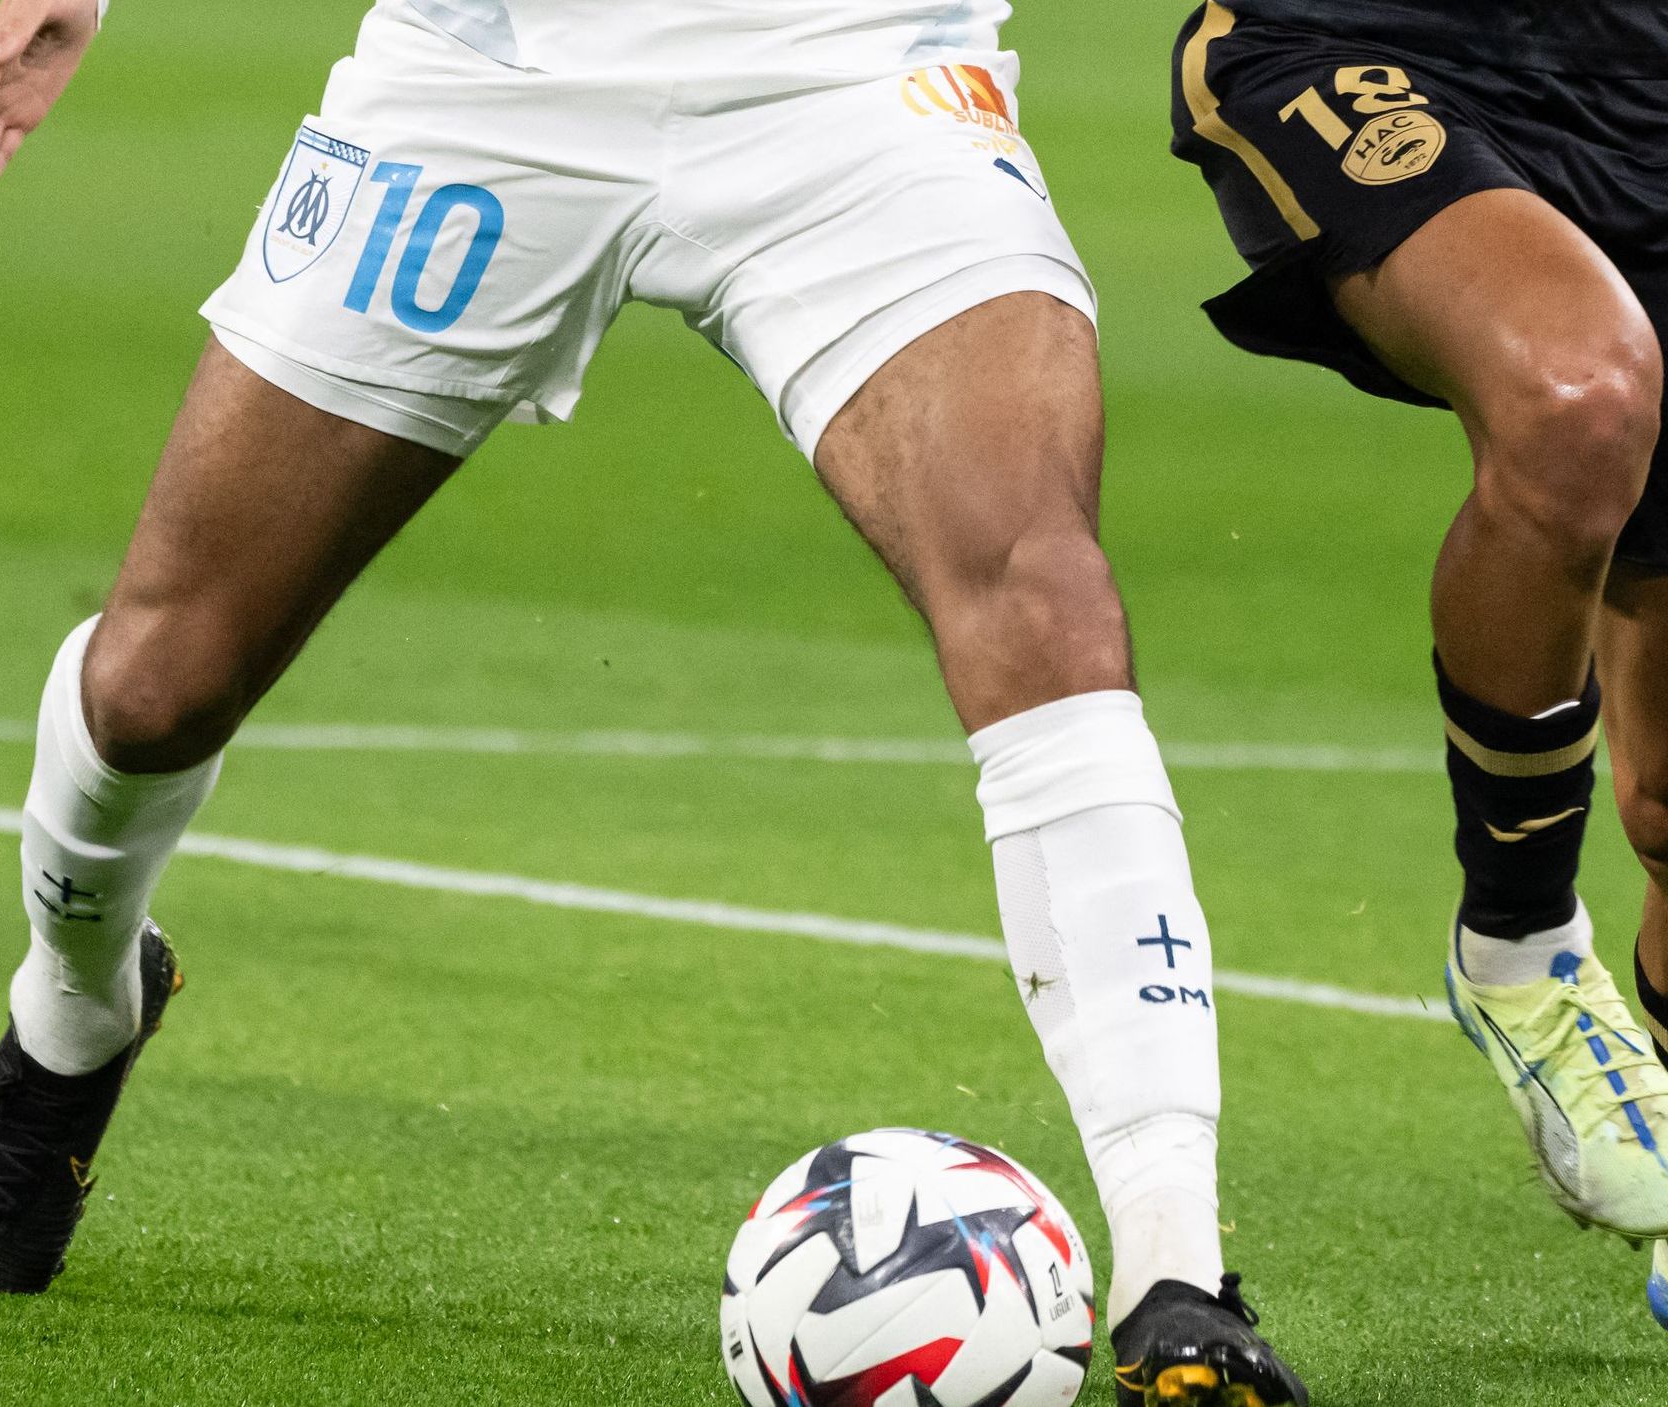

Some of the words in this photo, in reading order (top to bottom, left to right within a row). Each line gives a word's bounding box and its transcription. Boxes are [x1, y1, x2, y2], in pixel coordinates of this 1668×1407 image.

[1278, 65, 1430, 152] 18
[1355, 115, 1414, 160] HAC
[343, 161, 504, 333] 10
[1139, 984, 1210, 1008] OM
